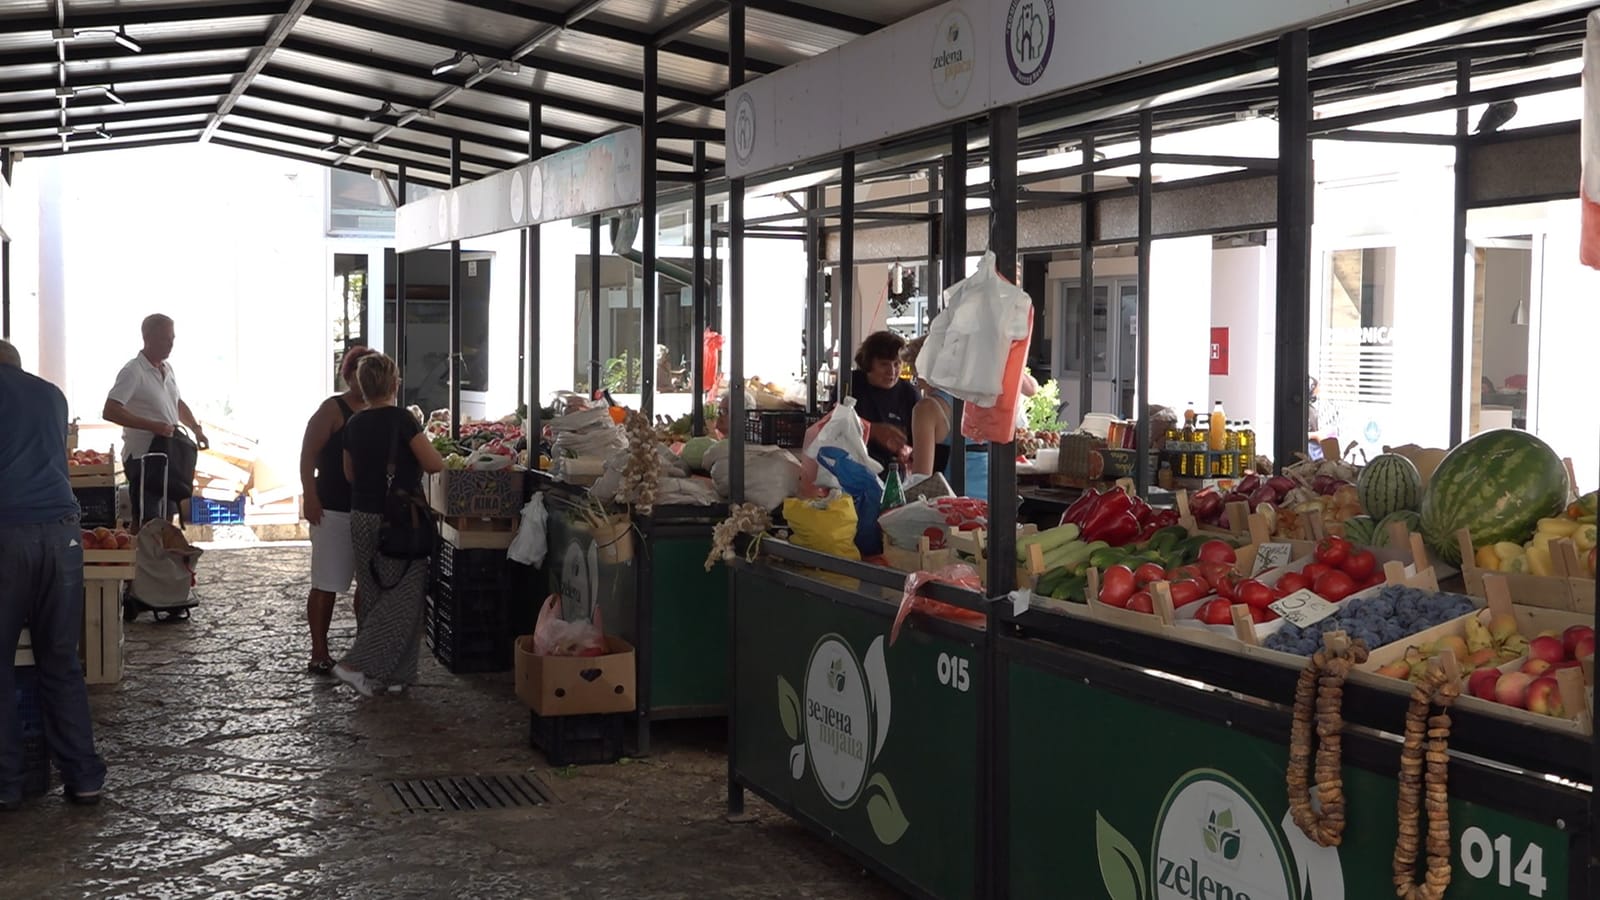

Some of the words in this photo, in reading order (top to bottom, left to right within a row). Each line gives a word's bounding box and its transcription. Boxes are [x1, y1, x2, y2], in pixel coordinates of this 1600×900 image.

[933, 50, 962, 69] zelena
[937, 652, 971, 692] 015
[807, 698, 853, 736] зелена
[1460, 826, 1548, 898] 014
